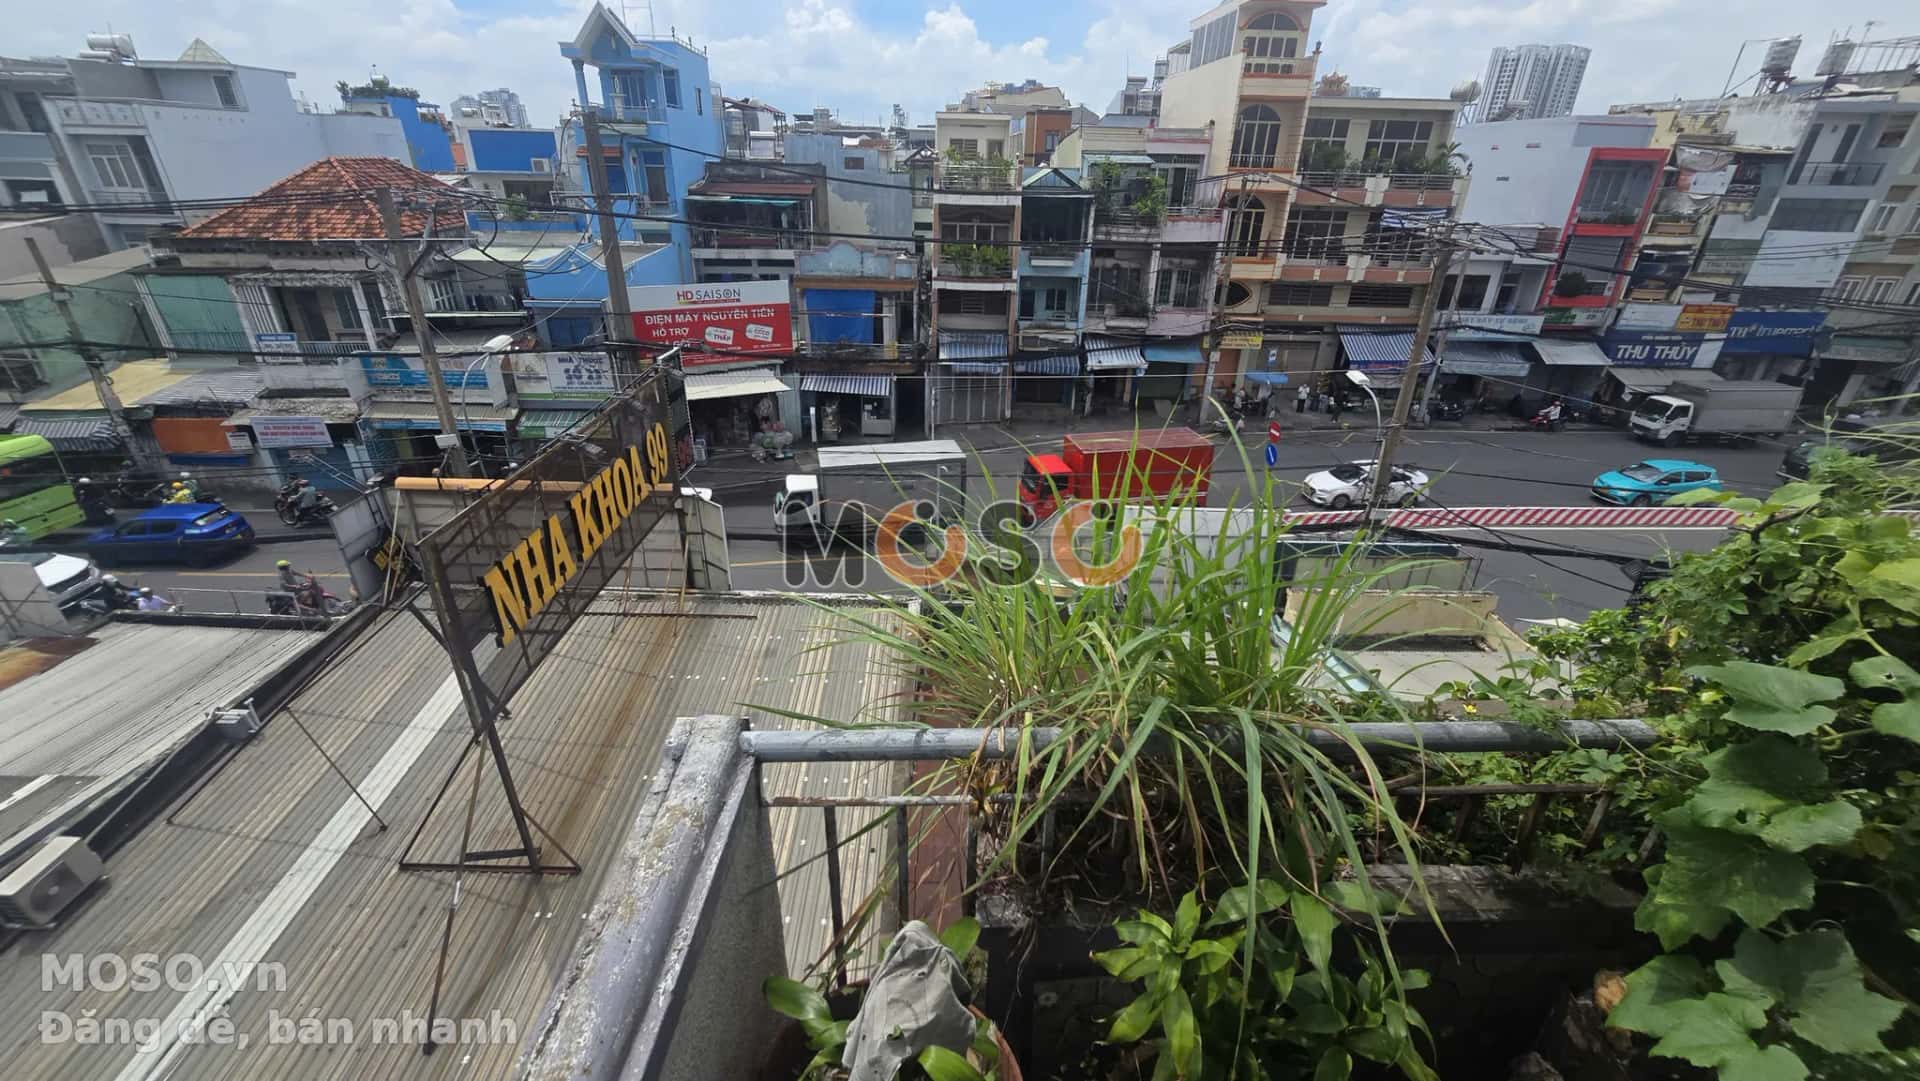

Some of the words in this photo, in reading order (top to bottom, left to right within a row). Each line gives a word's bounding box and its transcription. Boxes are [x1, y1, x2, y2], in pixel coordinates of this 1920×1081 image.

[676, 290, 694, 301] HD
[696, 288, 741, 300] SAISON
[1617, 344, 1650, 360] THU
[484, 513, 578, 648] NHA
[570, 445, 649, 562] KHOA
[646, 422, 668, 485] 99
